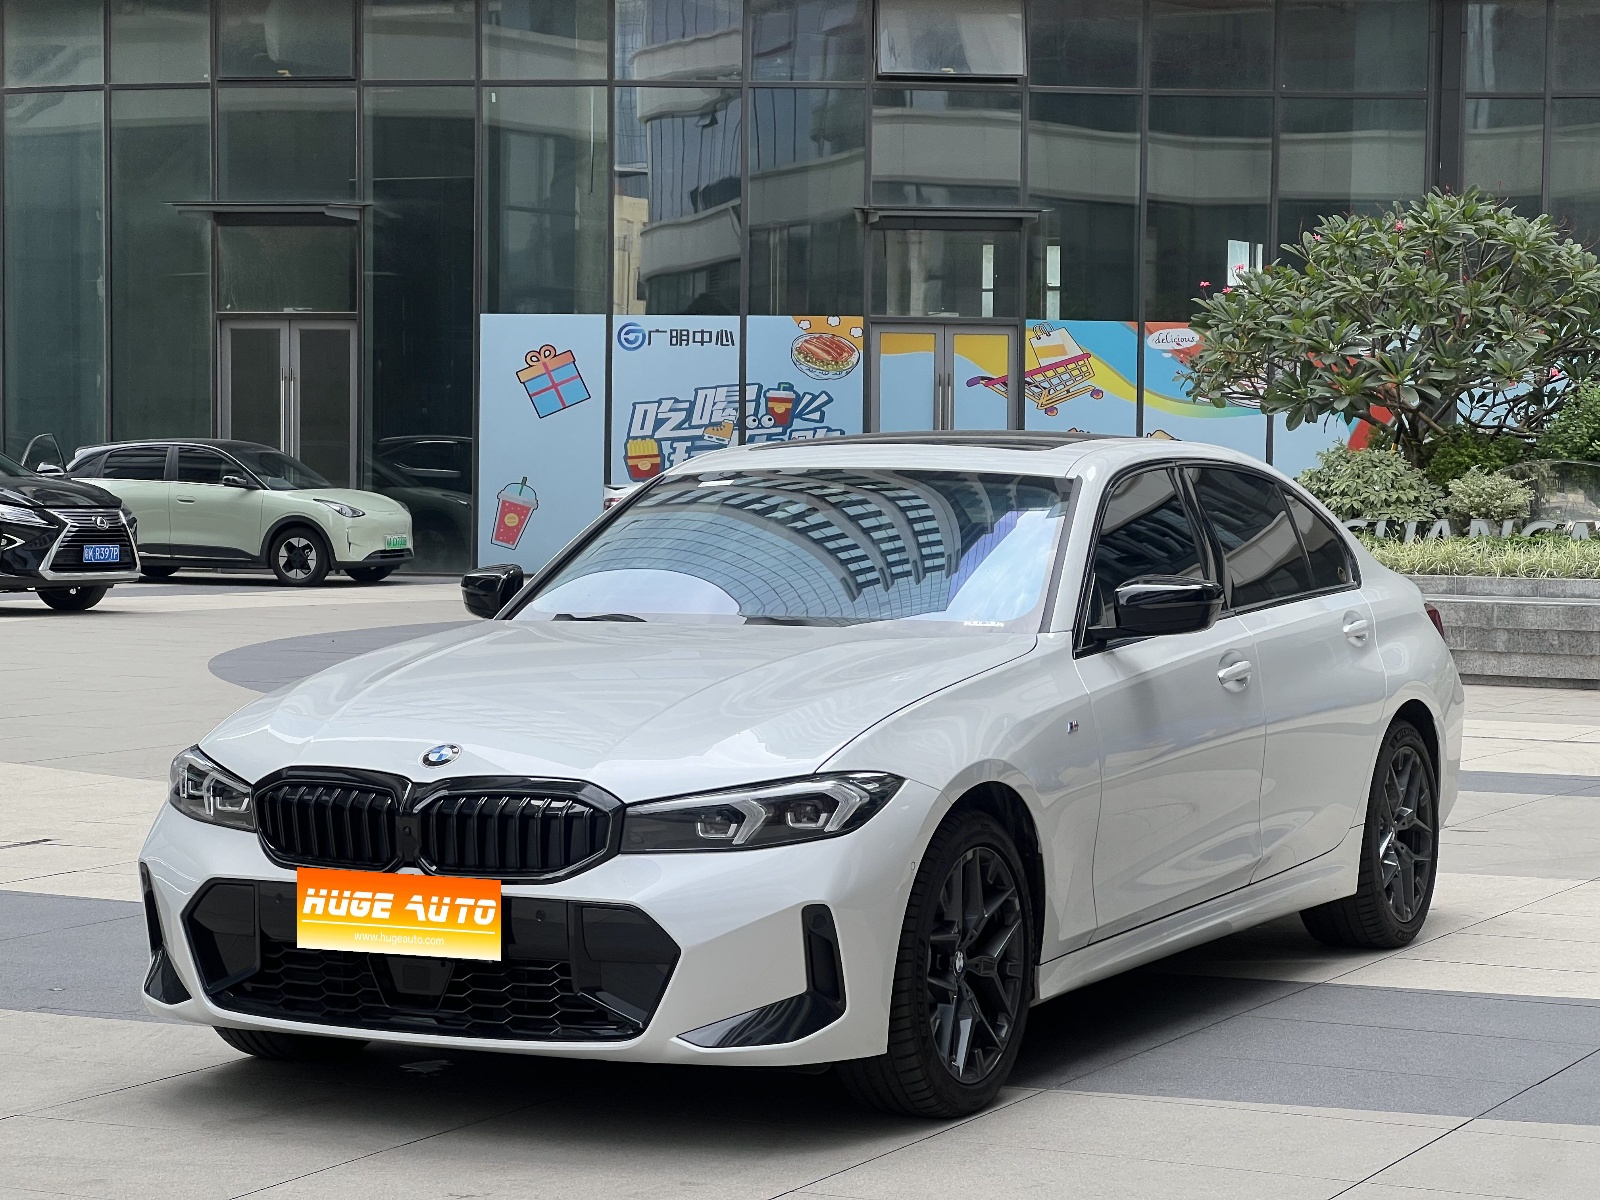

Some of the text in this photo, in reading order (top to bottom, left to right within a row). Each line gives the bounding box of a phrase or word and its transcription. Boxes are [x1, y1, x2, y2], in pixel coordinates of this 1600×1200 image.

[647, 328, 736, 346] 广明中心
[1154, 332, 1195, 344] delicious
